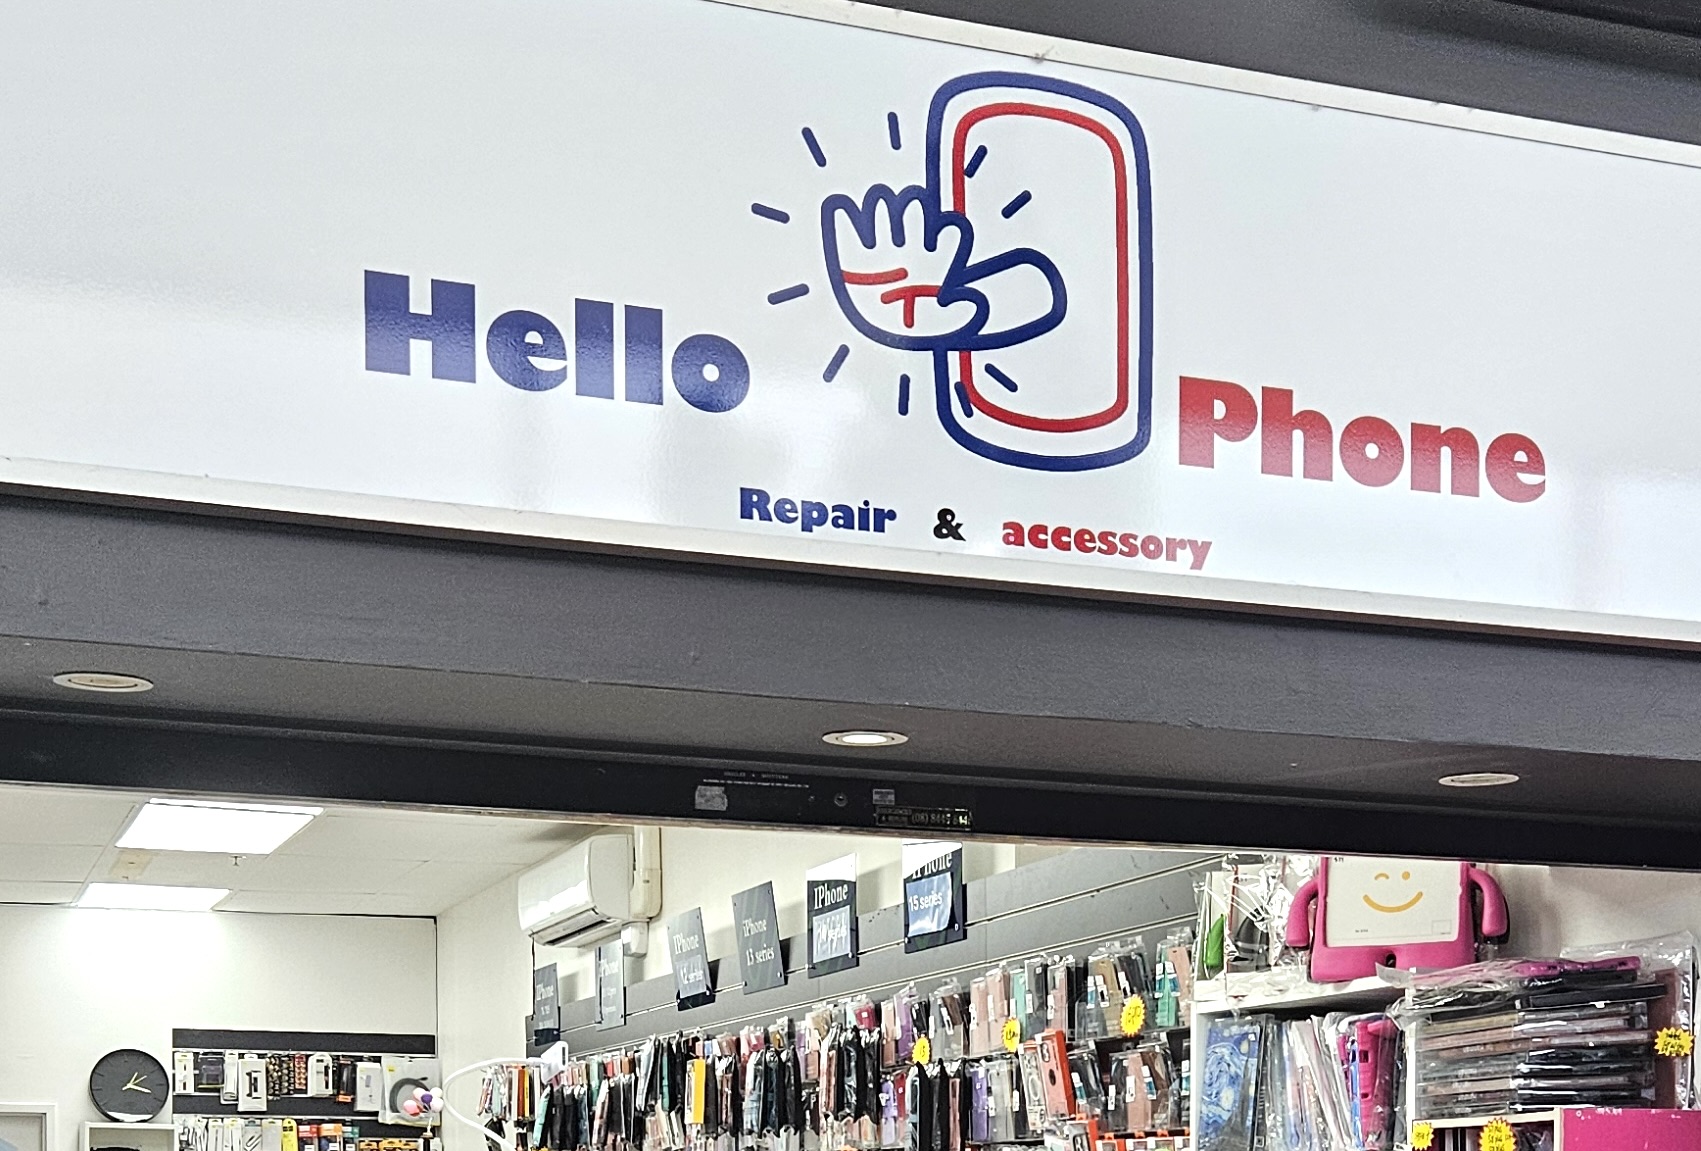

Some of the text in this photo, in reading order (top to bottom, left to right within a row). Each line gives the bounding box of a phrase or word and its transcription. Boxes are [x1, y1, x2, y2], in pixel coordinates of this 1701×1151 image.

[364, 269, 1546, 503] Hello Phone
[739, 486, 1213, 571] Repair & accessory
[813, 882, 849, 910] IPhone
[908, 890, 943, 912] 15 series
[755, 943, 775, 964] series
